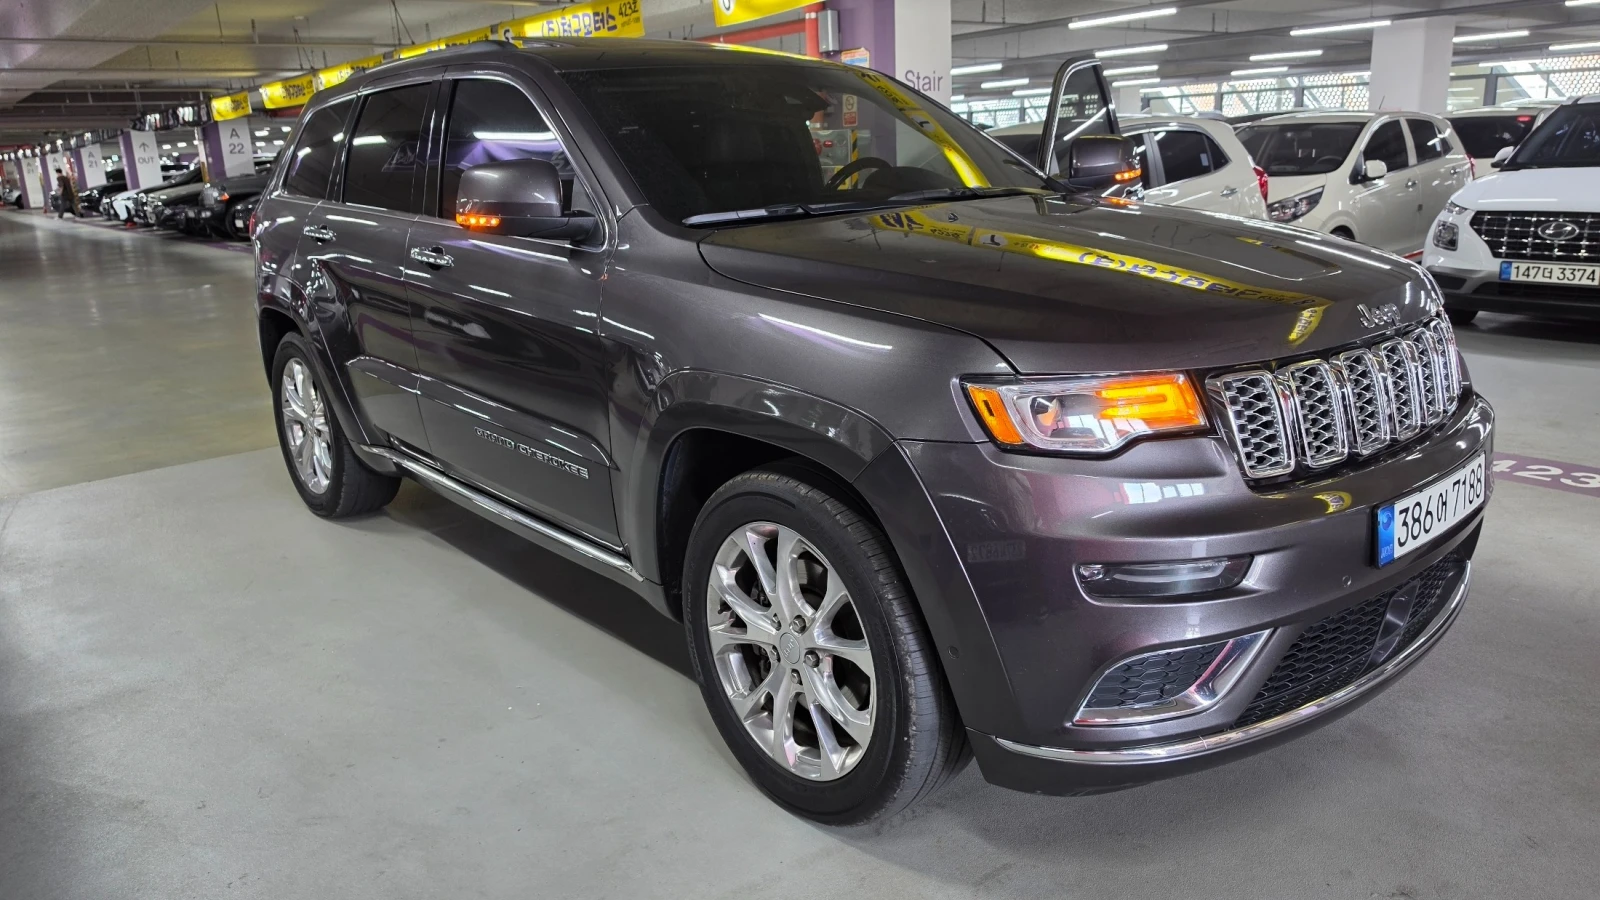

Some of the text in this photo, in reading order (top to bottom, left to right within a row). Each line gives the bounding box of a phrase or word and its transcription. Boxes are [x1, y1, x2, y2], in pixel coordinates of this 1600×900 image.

[905, 70, 943, 92] Stair
[230, 128, 240, 139] A
[88, 151, 95, 159] A
[229, 143, 245, 154] 22
[88, 160, 98, 168] 21
[1514, 265, 1596, 283] 147더 3374
[1357, 303, 1400, 328] Jeep
[474, 427, 589, 479] GRAND CHEROKEE
[1397, 463, 1483, 548] 386어 7188
